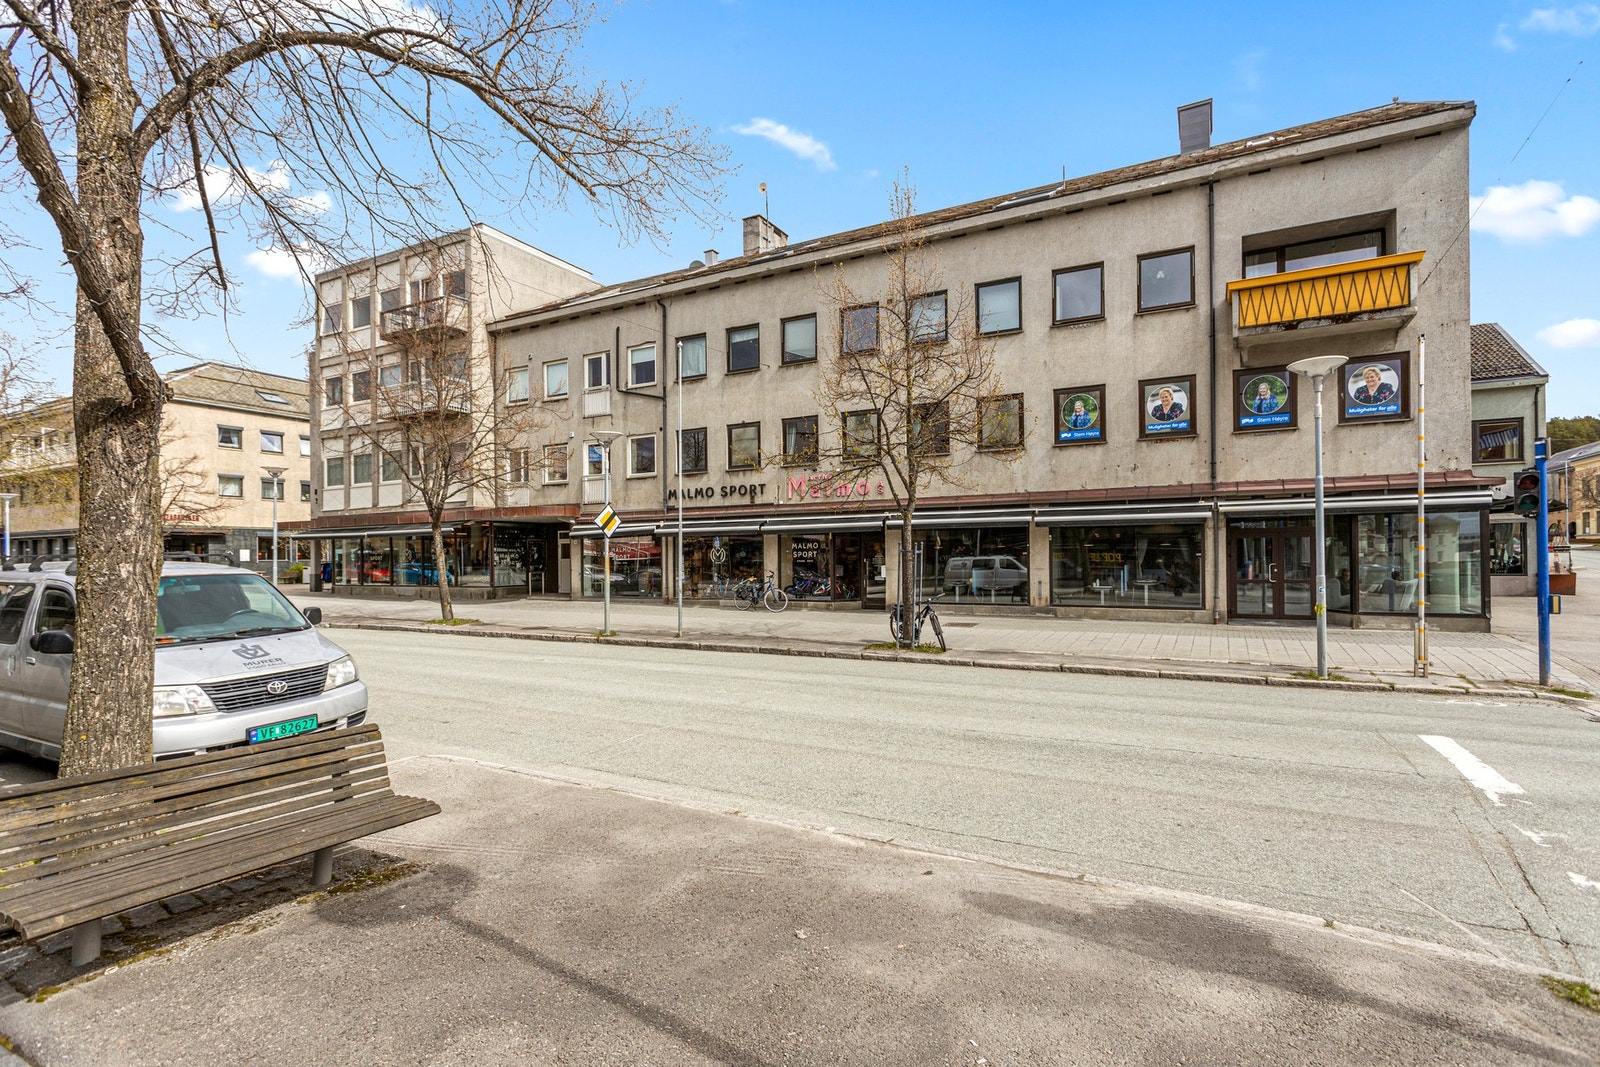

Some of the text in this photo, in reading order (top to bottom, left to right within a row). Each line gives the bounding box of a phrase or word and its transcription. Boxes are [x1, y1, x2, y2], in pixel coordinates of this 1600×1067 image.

[1348, 407, 1378, 415] Muligheter
[1271, 415, 1289, 424] Høyre
[1148, 422, 1172, 431] Muligheter
[1086, 430, 1100, 439] Høyre
[668, 483, 766, 500] MALMO SPORT
[793, 550, 817, 558] SPORT
[243, 657, 283, 667] MURER
[260, 727, 276, 739] VF
[280, 718, 315, 735] 82627
